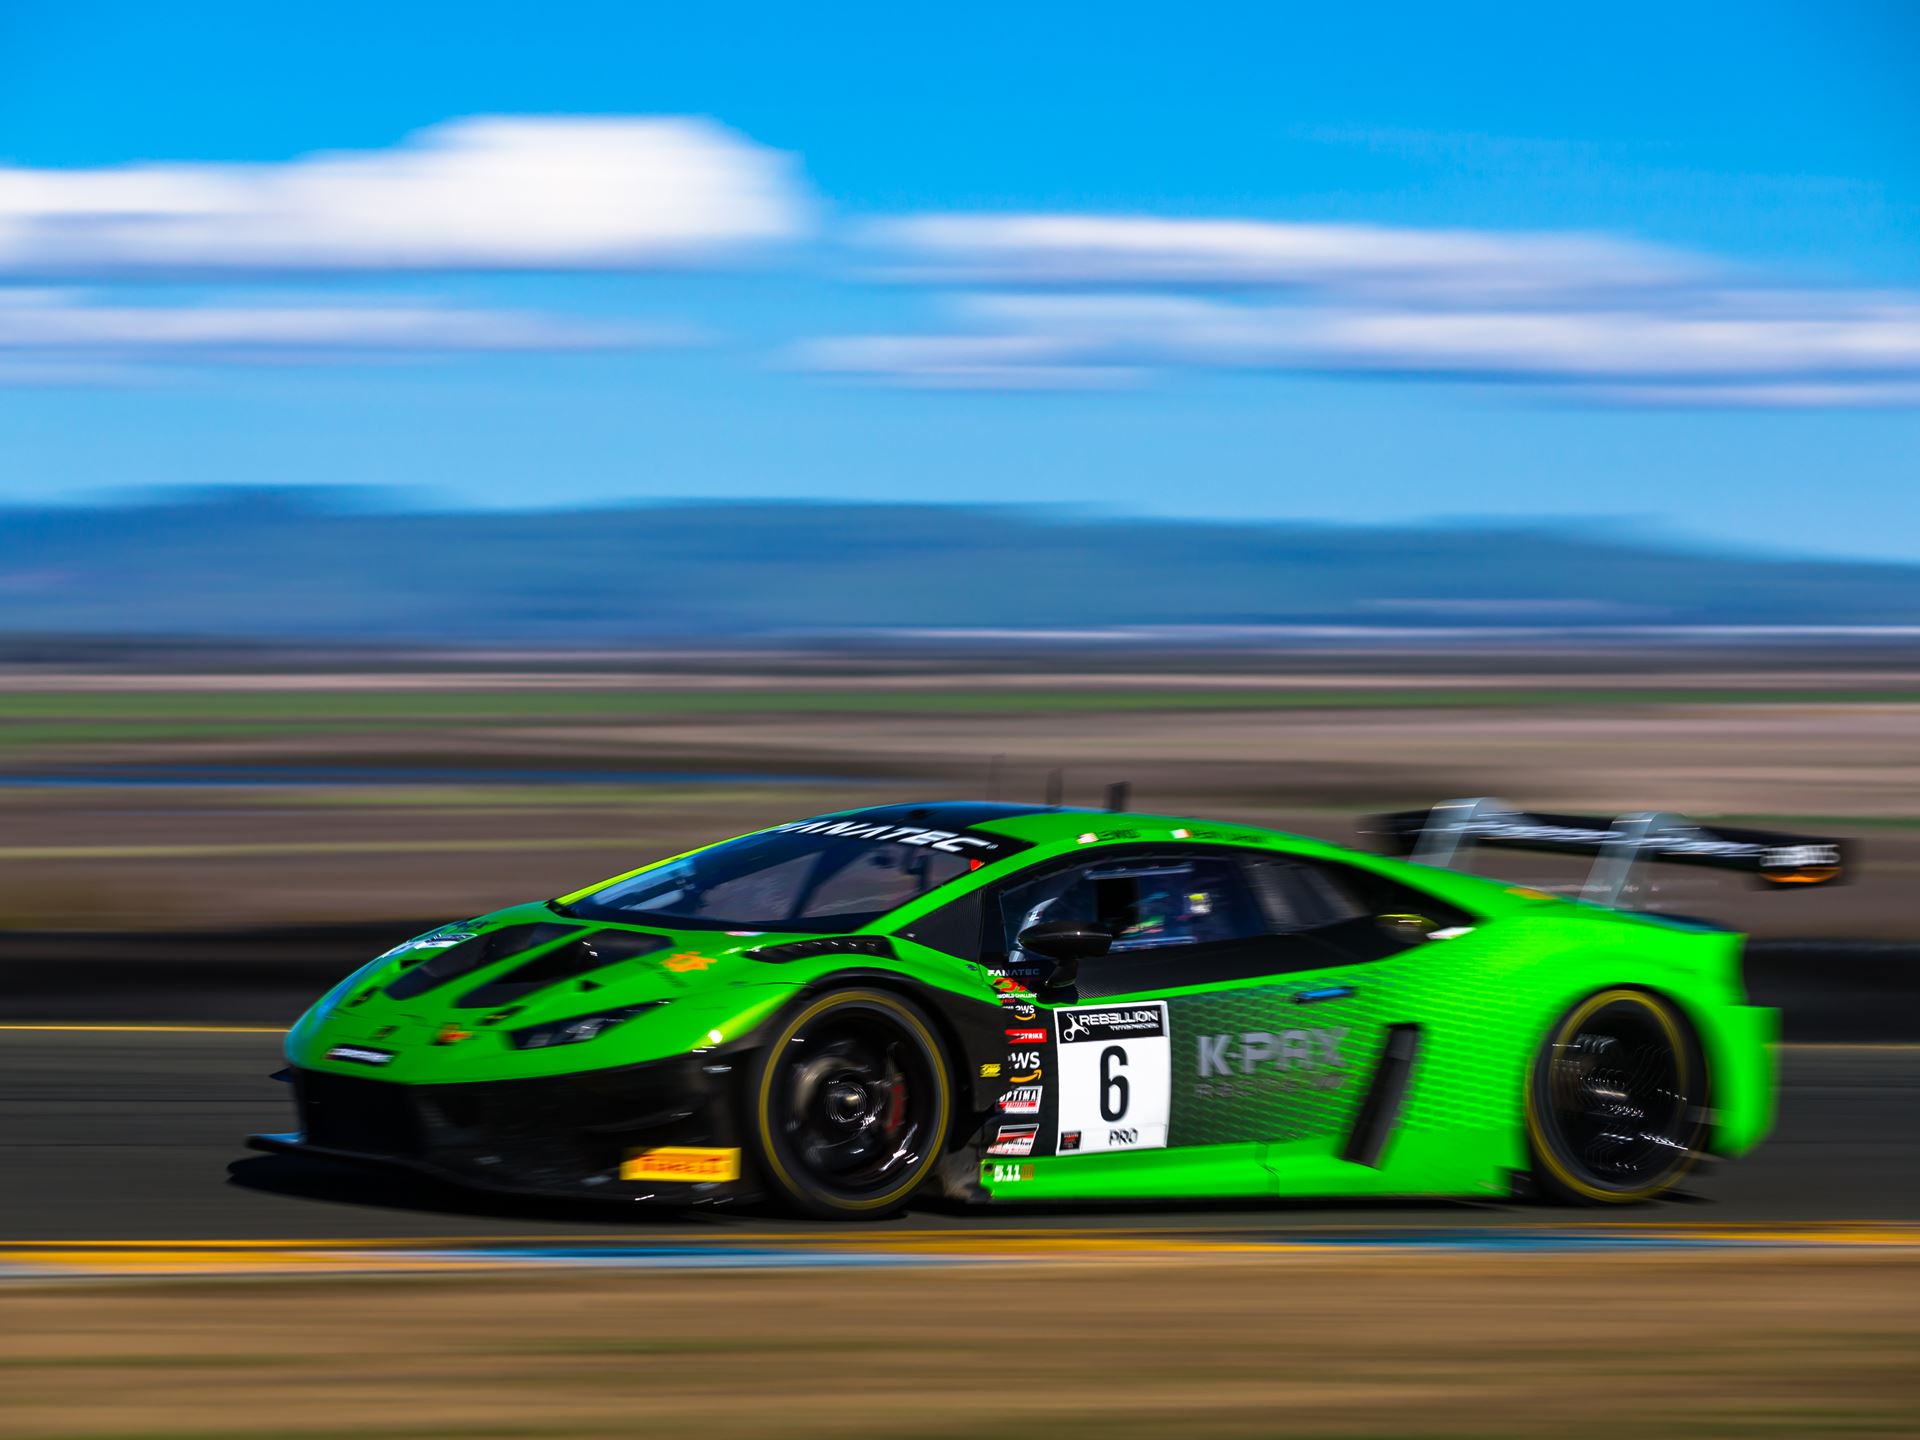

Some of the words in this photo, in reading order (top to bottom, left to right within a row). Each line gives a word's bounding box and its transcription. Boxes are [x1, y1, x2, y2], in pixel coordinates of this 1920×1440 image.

[1079, 1010, 1159, 1026] REBELLION
[1100, 1045, 1129, 1122] 6
[1109, 1128, 1138, 1145] PRO
